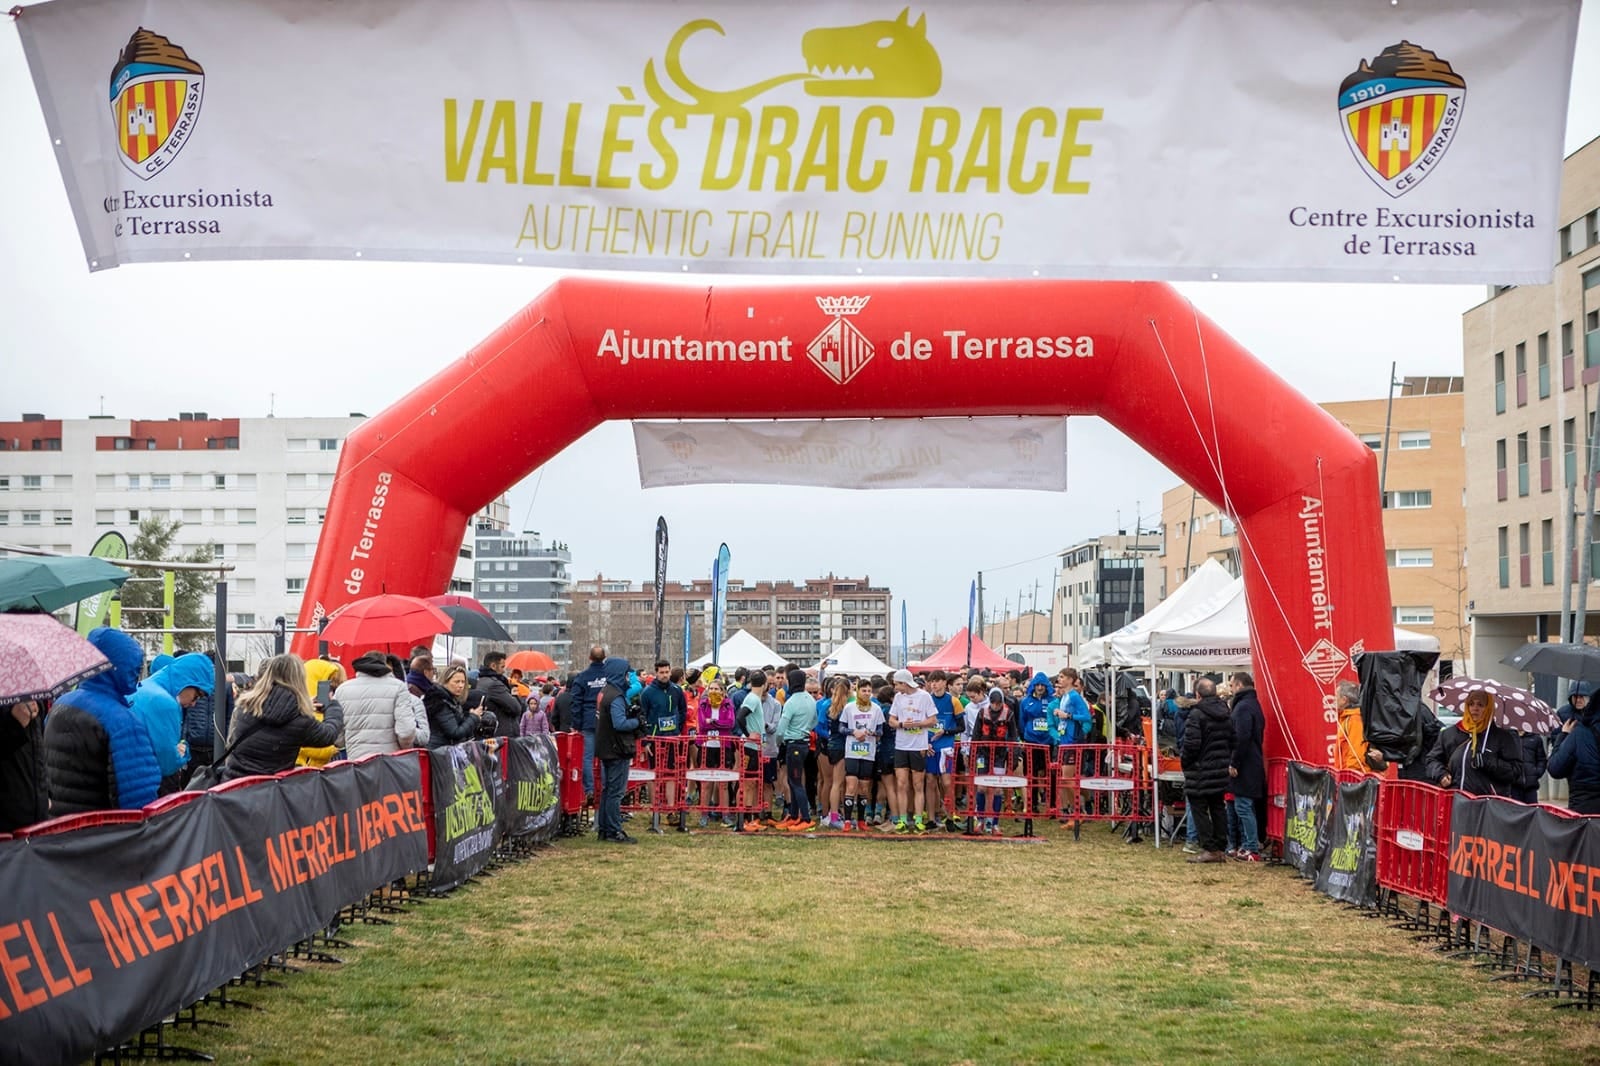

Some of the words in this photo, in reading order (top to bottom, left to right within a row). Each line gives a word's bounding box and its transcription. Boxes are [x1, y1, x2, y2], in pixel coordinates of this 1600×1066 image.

[1350, 83, 1386, 103] 1910
[145, 155, 165, 173] CE
[163, 81, 200, 155] TERRASSA
[443, 86, 688, 191] VALLÈS
[699, 105, 895, 193] DRAC
[908, 106, 1105, 195] RACE
[1395, 172, 1416, 190] CE
[1415, 96, 1461, 173] TERRASSA
[123, 188, 273, 209] Excursionista
[1289, 206, 1368, 228] Centre
[1375, 208, 1535, 230] Excursionista
[126, 216, 221, 236] Terrassa
[515, 203, 713, 258] AUTHENTIC
[726, 209, 828, 260] TRAIL
[839, 210, 1004, 262] RUNNING
[1343, 234, 1372, 255] de
[1380, 235, 1477, 257] Terrassa
[597, 328, 793, 365] Ajuntament
[890, 331, 933, 360] de
[943, 330, 1095, 360] Terrassa
[351, 471, 393, 562] Terrassa
[344, 567, 366, 595] de
[1298, 495, 1333, 630] Ajuntament
[1162, 647, 1208, 656] ASSOCIACIÓ
[1209, 648, 1222, 656] PEL
[1449, 831, 1540, 899] MERRELL
[89, 846, 264, 968] MERRELL
[265, 812, 357, 893] MERRELL
